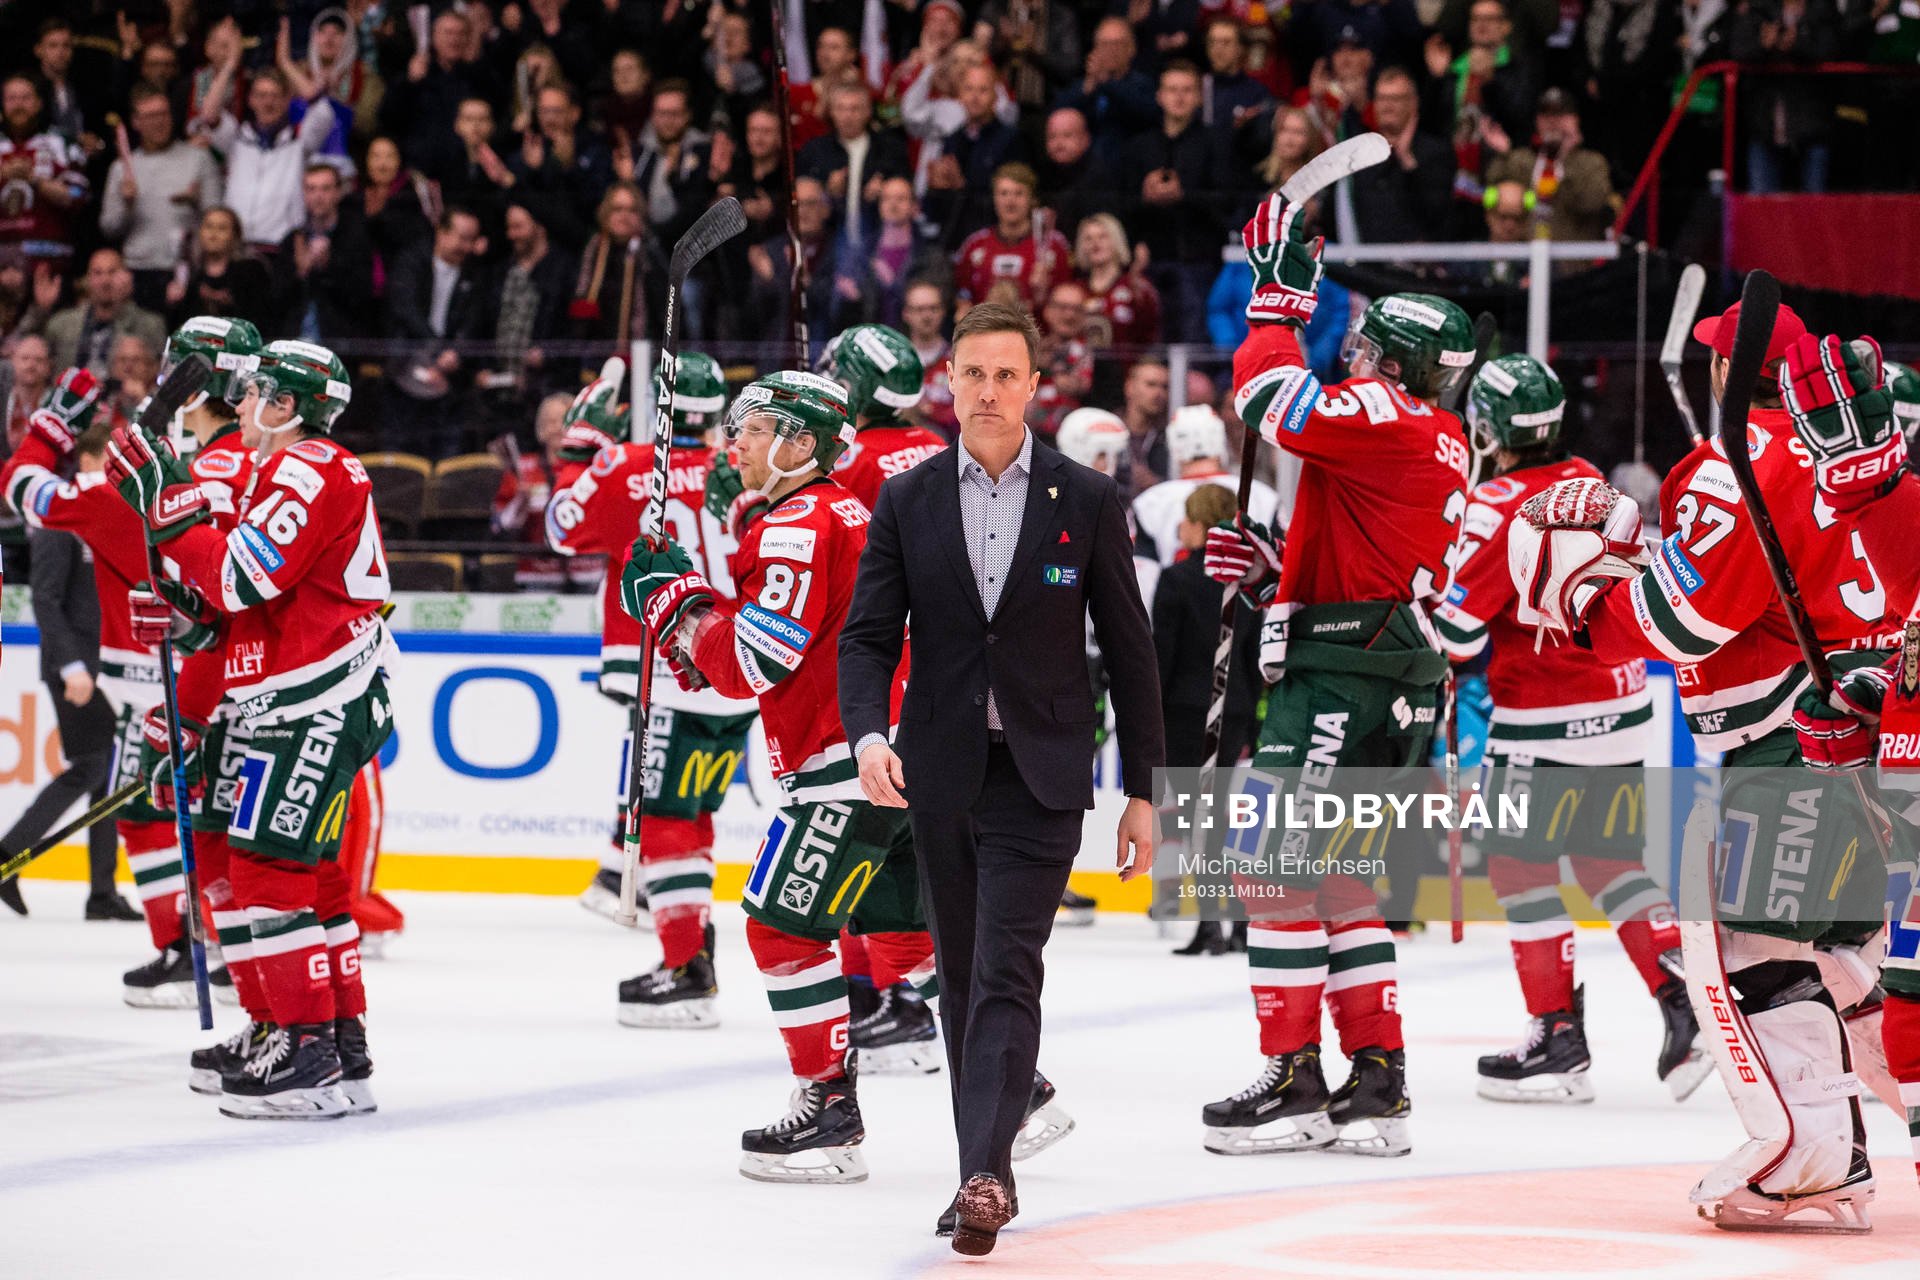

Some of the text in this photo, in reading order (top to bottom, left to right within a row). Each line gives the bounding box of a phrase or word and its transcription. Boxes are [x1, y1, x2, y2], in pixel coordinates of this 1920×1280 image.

[649, 348, 675, 535] EASTON
[247, 489, 308, 546] 46
[763, 541, 805, 551] KUMHO TYRE
[758, 562, 813, 621] 81
[743, 606, 806, 645] EHRENBORG
[1313, 621, 1361, 633] BAUER
[235, 640, 264, 658] FILM
[740, 644, 757, 682] AIRLINES
[756, 636, 787, 660] AIRLINES
[238, 691, 278, 718] SKF
[1566, 714, 1621, 739] SKF
[1696, 711, 1727, 733] SKF
[1765, 788, 1824, 922] STENA
[1706, 985, 1758, 1083] BAUER
